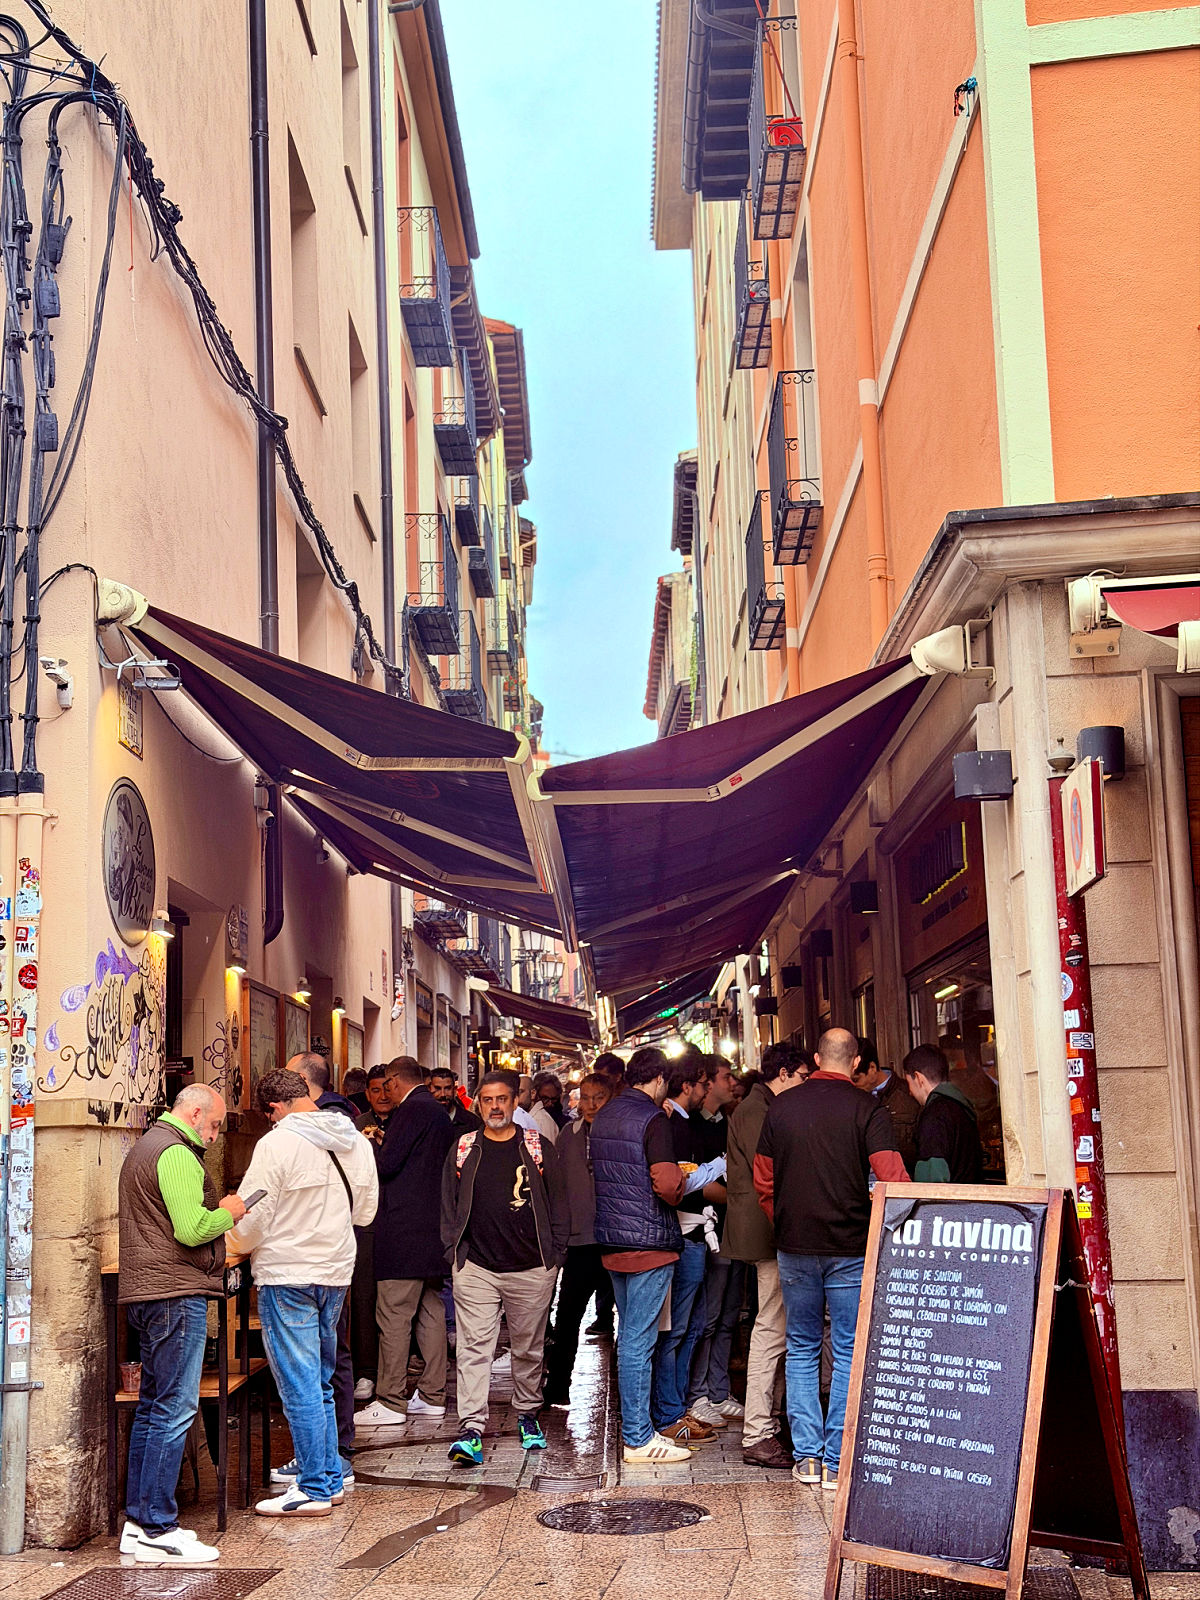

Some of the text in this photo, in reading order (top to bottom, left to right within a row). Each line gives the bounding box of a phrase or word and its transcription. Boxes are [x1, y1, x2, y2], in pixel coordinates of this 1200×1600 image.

[931, 1215, 1033, 1252] tavina
[891, 1248, 1030, 1265] VINOS Y COMIDAS
[890, 1268, 962, 1282] ANCHOAS DE SANTOÑA
[887, 1282, 983, 1299] CROQUETAS CASERAS DE JAMÓN
[886, 1294, 914, 1306] ENSALADA
[918, 1297, 926, 1307] DE
[954, 1300, 962, 1310] DE
[964, 1301, 991, 1313] LOGROÑO
[994, 1304, 1007, 1314] CON
[917, 1310, 947, 1322] CEBOLLETA
[882, 1324, 933, 1338] TABLA DE QUESOS
[881, 1335, 901, 1346] JAMÓN
[902, 1350, 910, 1360] DE
[930, 1353, 942, 1363] CON
[942, 1355, 963, 1365] HELADO
[966, 1358, 973, 1367] DE
[934, 1366, 945, 1376] CON
[965, 1370, 970, 1379] A
[876, 1373, 914, 1386] LECHERILLAS
[918, 1378, 925, 1388] DE
[928, 1379, 954, 1391] CORDERO
[966, 1382, 990, 1395] PADRÓN
[874, 1386, 896, 1399] TARTAR
[899, 1390, 909, 1400] DE
[905, 1404, 927, 1415] ASADOS
[930, 1408, 935, 1416] A
[936, 1409, 943, 1417] LA
[946, 1409, 961, 1420] LEÑA
[871, 1412, 930, 1429] HUEVOS CON JAMÓN
[867, 1439, 900, 1455] PIPARRAS
[869, 1425, 994, 1455] CECINA DE LEÓN CON ACEITE ARBEQUINA
[901, 1461, 908, 1470] DE
[910, 1462, 926, 1473] BUEY
[930, 1466, 941, 1476] CON
